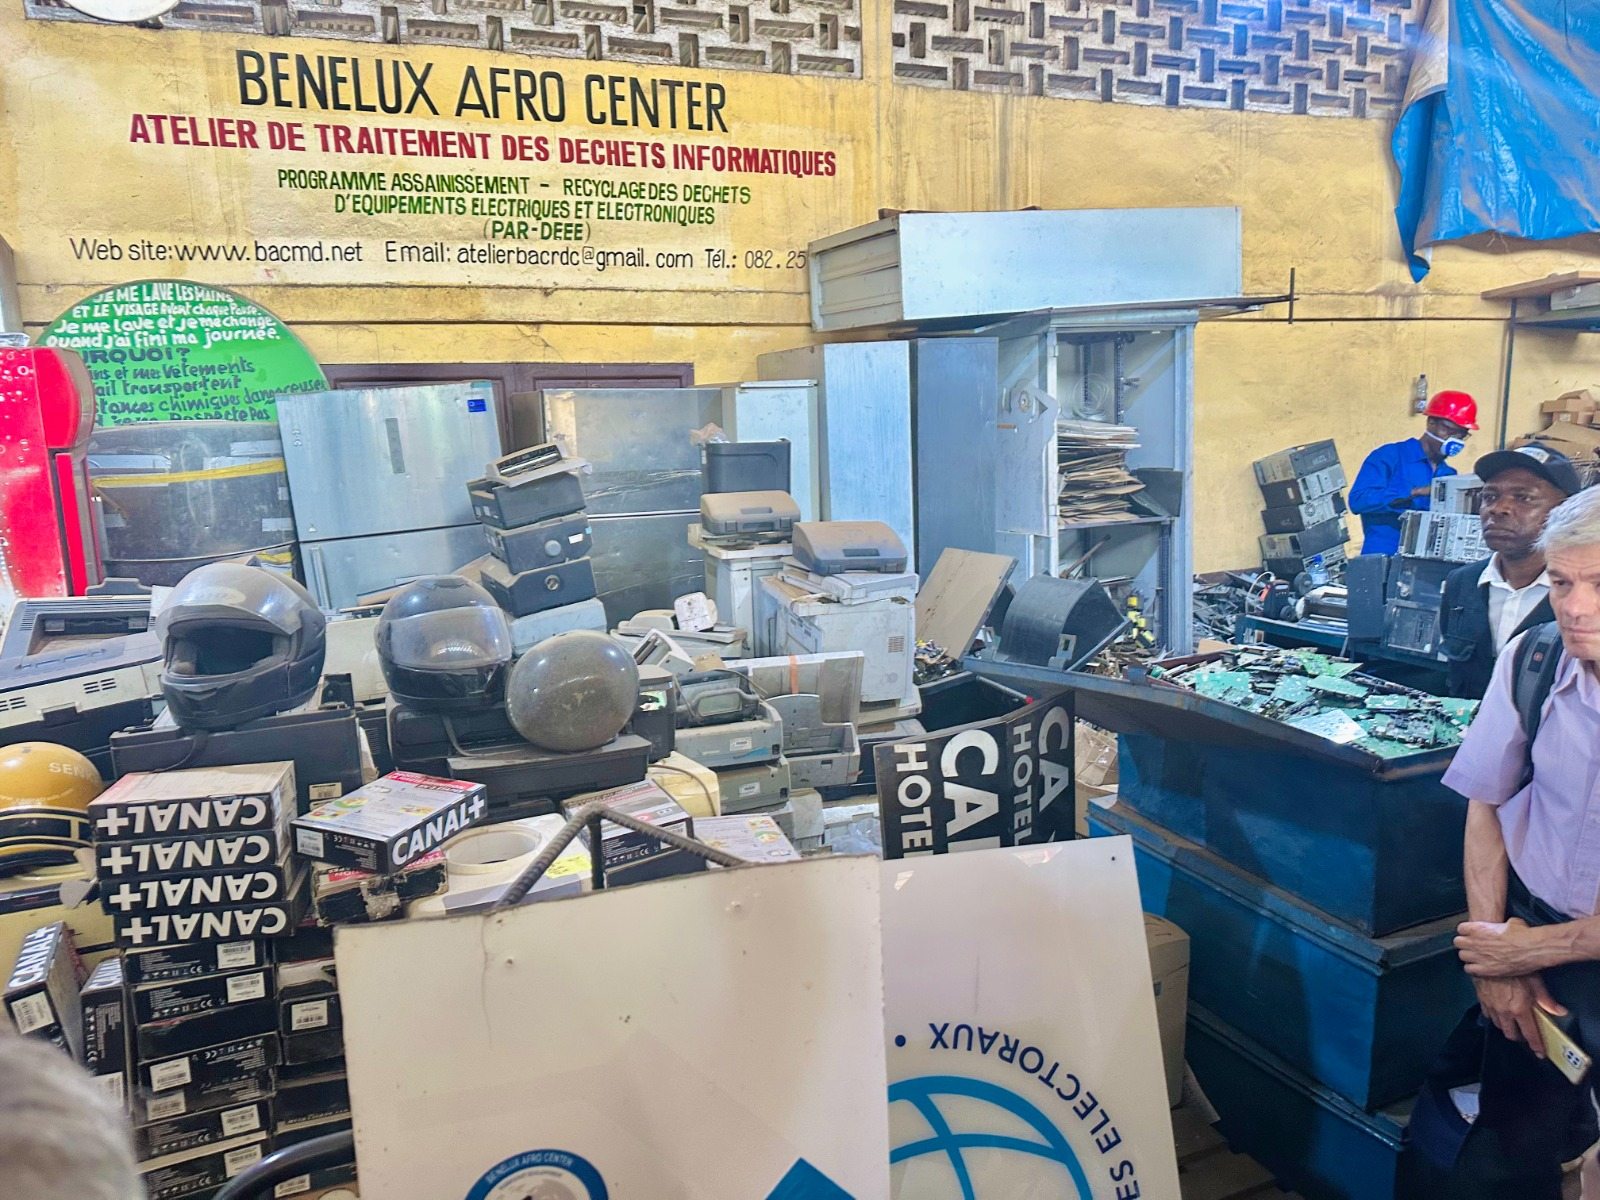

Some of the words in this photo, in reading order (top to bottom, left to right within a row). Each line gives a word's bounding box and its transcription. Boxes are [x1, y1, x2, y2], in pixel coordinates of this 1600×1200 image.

[236, 50, 439, 116] BENELUX
[455, 65, 565, 122] AFRO
[585, 74, 728, 133] CENTER
[129, 113, 259, 149] ATELIER
[267, 121, 306, 152] DE
[314, 123, 491, 160] TRAITEMENT
[502, 135, 550, 162] DES
[559, 137, 666, 168] DECHETS
[673, 143, 836, 178] INFORMATIQUES
[278, 169, 387, 190] PROGRAMME
[391, 173, 530, 195] ASSAINISSEMENT
[563, 178, 645, 199] RECYCLAGE
[649, 182, 678, 201] DES
[683, 183, 751, 204] DECHETS
[335, 194, 466, 216] D'EQUIPEMENTS
[471, 197, 570, 221] ELECTRIQUES
[574, 201, 593, 220] ET
[597, 202, 715, 226] ELECTRONIQUES
[483, 218, 592, 243] (PAR-DEEE)
[69, 238, 122, 260] Web
[385, 240, 450, 262] Email:
[72, 305, 90, 318] ET
[93, 304, 109, 317] LE
[113, 303, 158, 316] VISAGE
[93, 290, 114, 303] JE
[116, 285, 139, 302] ME
[142, 283, 173, 301] LAVE
[175, 283, 194, 301] LES
[194, 286, 234, 303] MAINS
[54, 320, 80, 333] Je
[82, 322, 111, 333] me
[113, 317, 154, 332] lave
[157, 315, 175, 329] et
[133, 329, 167, 347] fini
[171, 333, 199, 346] ma
[115, 366, 128, 379] et
[941, 730, 1000, 853] CA
[1011, 722, 1033, 846] HOTEL
[1038, 706, 1070, 843] CA
[97, 798, 267, 836] CANAL+
[392, 795, 485, 865] CANAL+
[101, 836, 270, 874] CANAL+
[109, 872, 278, 911] CANAL+
[121, 907, 287, 944] CANAL+
[9, 926, 57, 988] CANAL+
[928, 1022, 1122, 1155] ELECTORAUX
